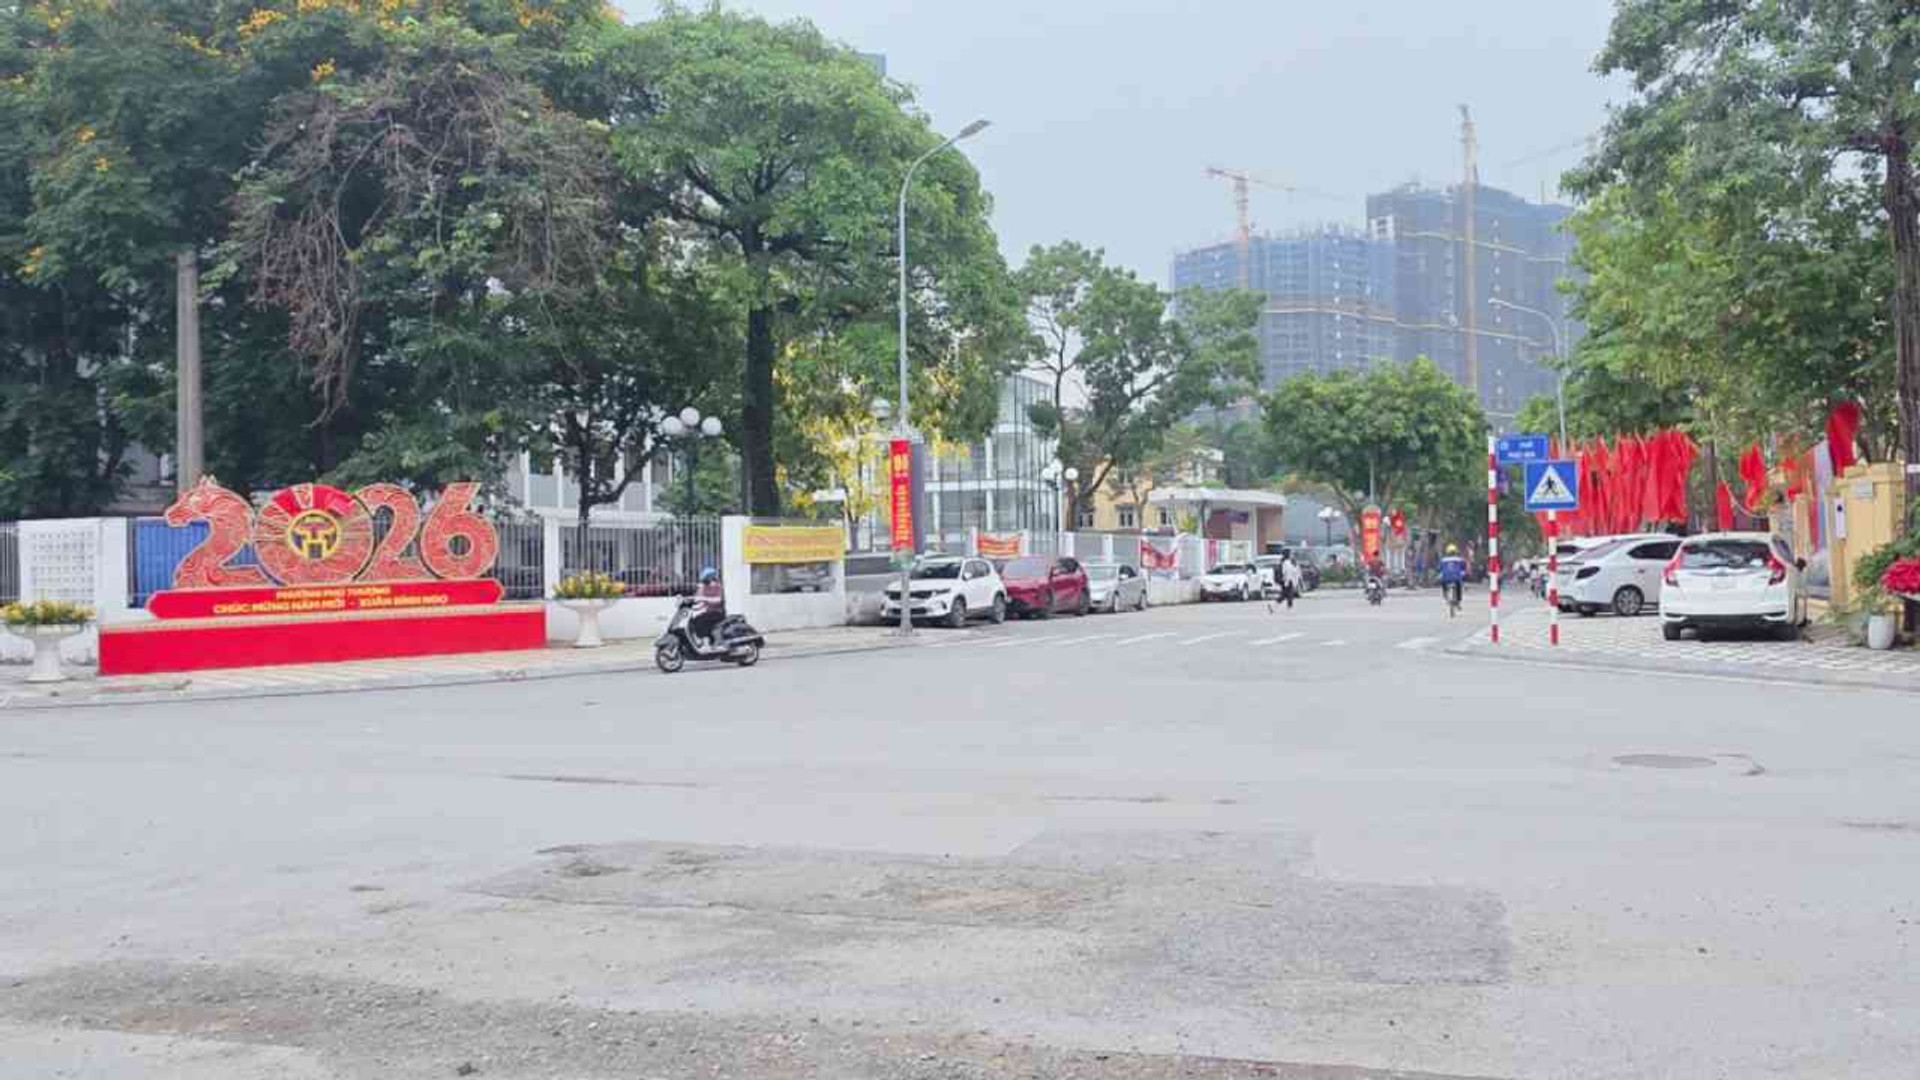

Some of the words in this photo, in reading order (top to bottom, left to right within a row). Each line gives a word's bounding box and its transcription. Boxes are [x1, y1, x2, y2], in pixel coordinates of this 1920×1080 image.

[164, 479, 497, 588] 2026
[213, 602, 252, 614] CHÚC
[252, 600, 290, 613] MỪNG
